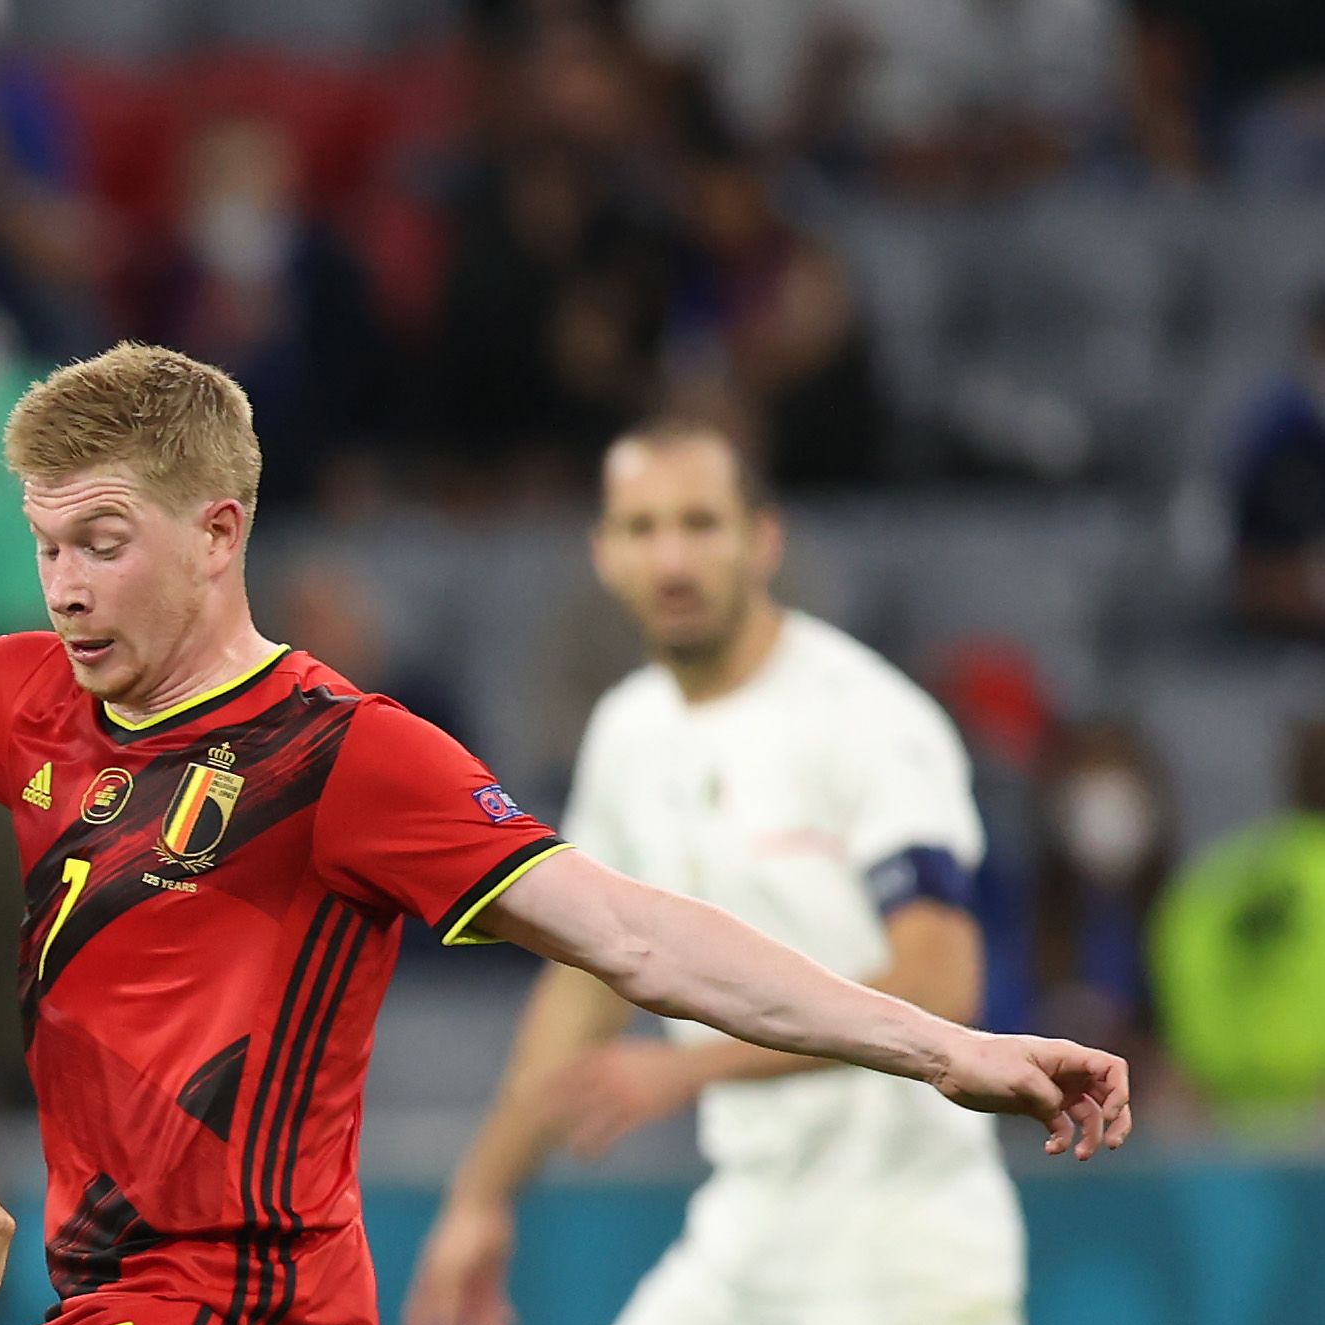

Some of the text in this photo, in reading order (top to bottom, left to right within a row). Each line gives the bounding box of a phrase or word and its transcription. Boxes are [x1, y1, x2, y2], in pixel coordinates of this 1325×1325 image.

[141, 872, 199, 893] 125 YEARS
[38, 858, 92, 981] 7
